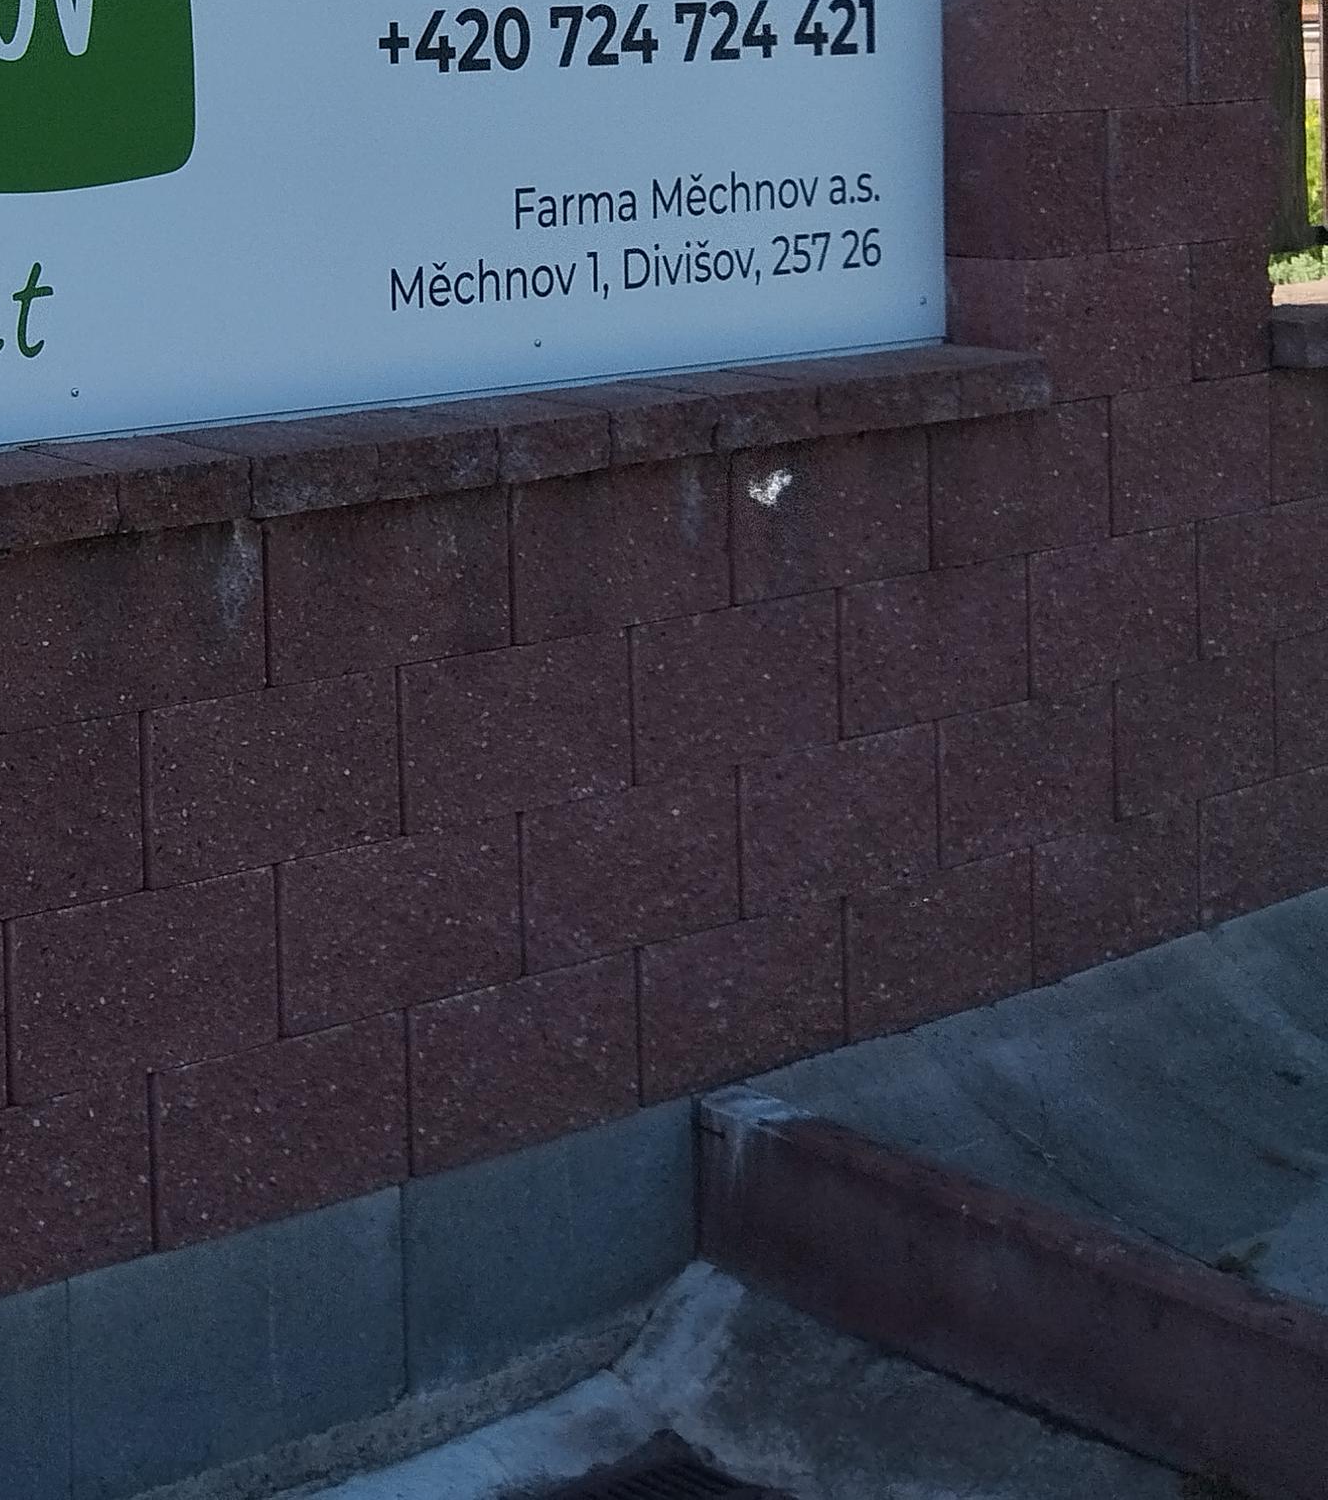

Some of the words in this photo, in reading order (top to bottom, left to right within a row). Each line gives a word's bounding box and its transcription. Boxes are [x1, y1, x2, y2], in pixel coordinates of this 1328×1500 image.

[377, 6, 532, 74] +420
[549, 3, 659, 68] 724
[674, 0, 779, 63] 724
[514, 186, 638, 230] Farma
[650, 171, 819, 218] Měchnov
[828, 171, 882, 204] a.s.
[390, 259, 578, 312] Měchnov
[585, 251, 610, 299] 1,
[622, 235, 763, 290] Divišov,
[771, 232, 831, 276] 257
[842, 228, 884, 270] 26
